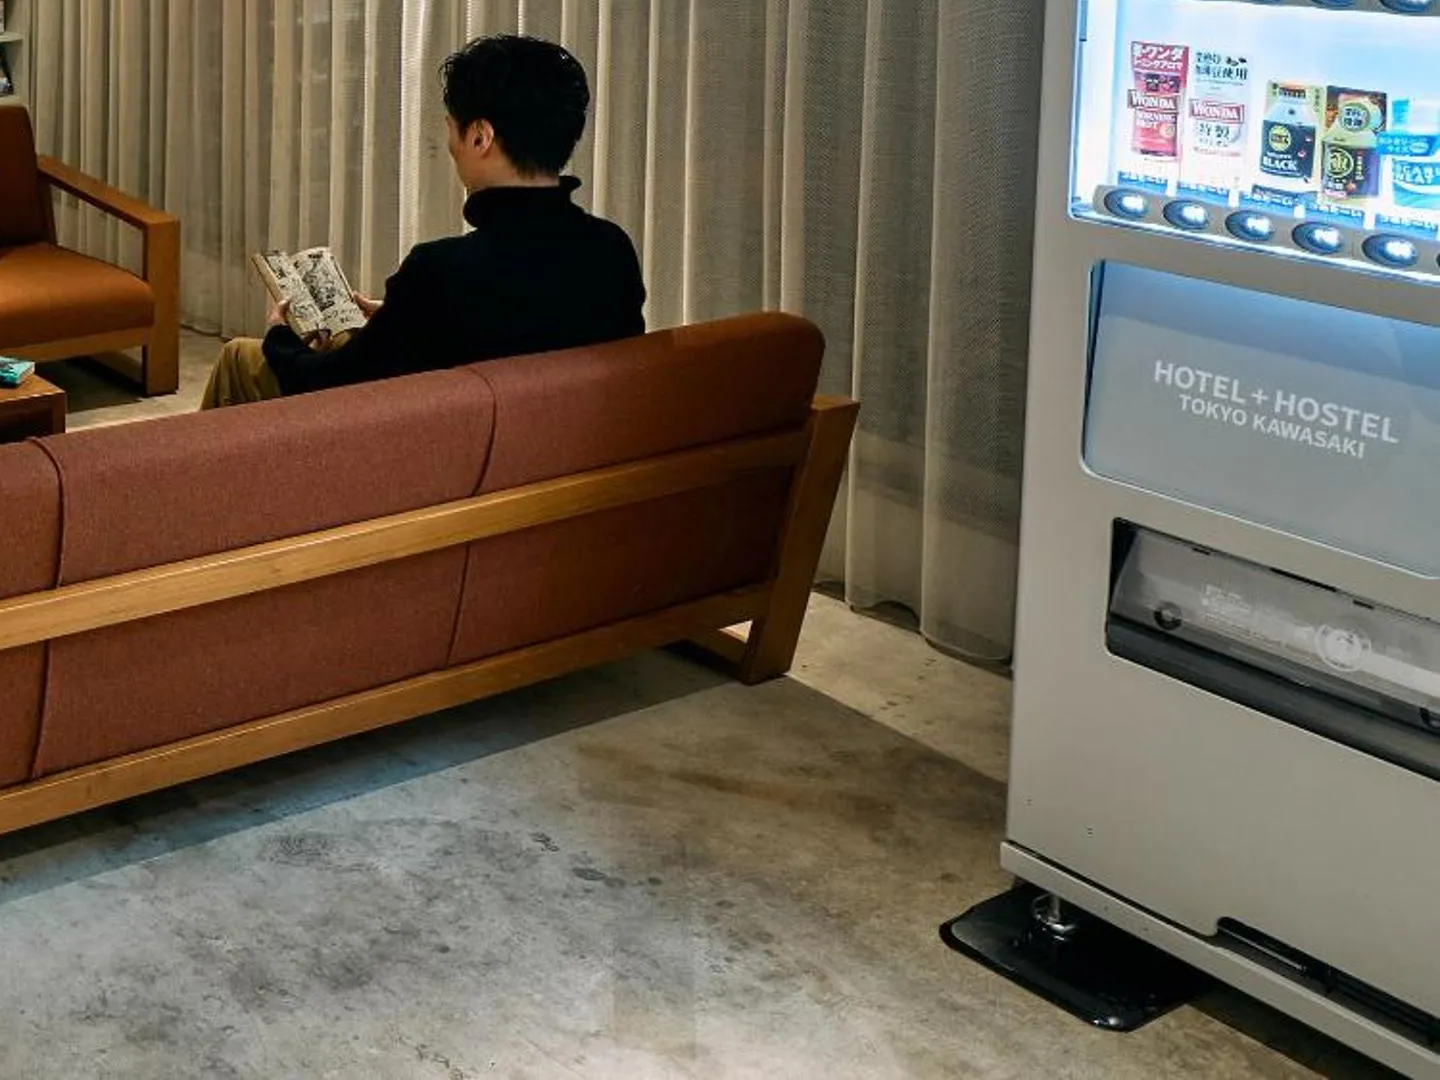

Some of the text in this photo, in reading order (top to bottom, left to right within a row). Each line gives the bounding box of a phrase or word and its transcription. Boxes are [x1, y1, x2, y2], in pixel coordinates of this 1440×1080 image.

[1153, 360, 1246, 403] HOTEL
[1274, 389, 1400, 443] HOSTEL
[1178, 394, 1366, 459] TOKYO KAWASAKI
